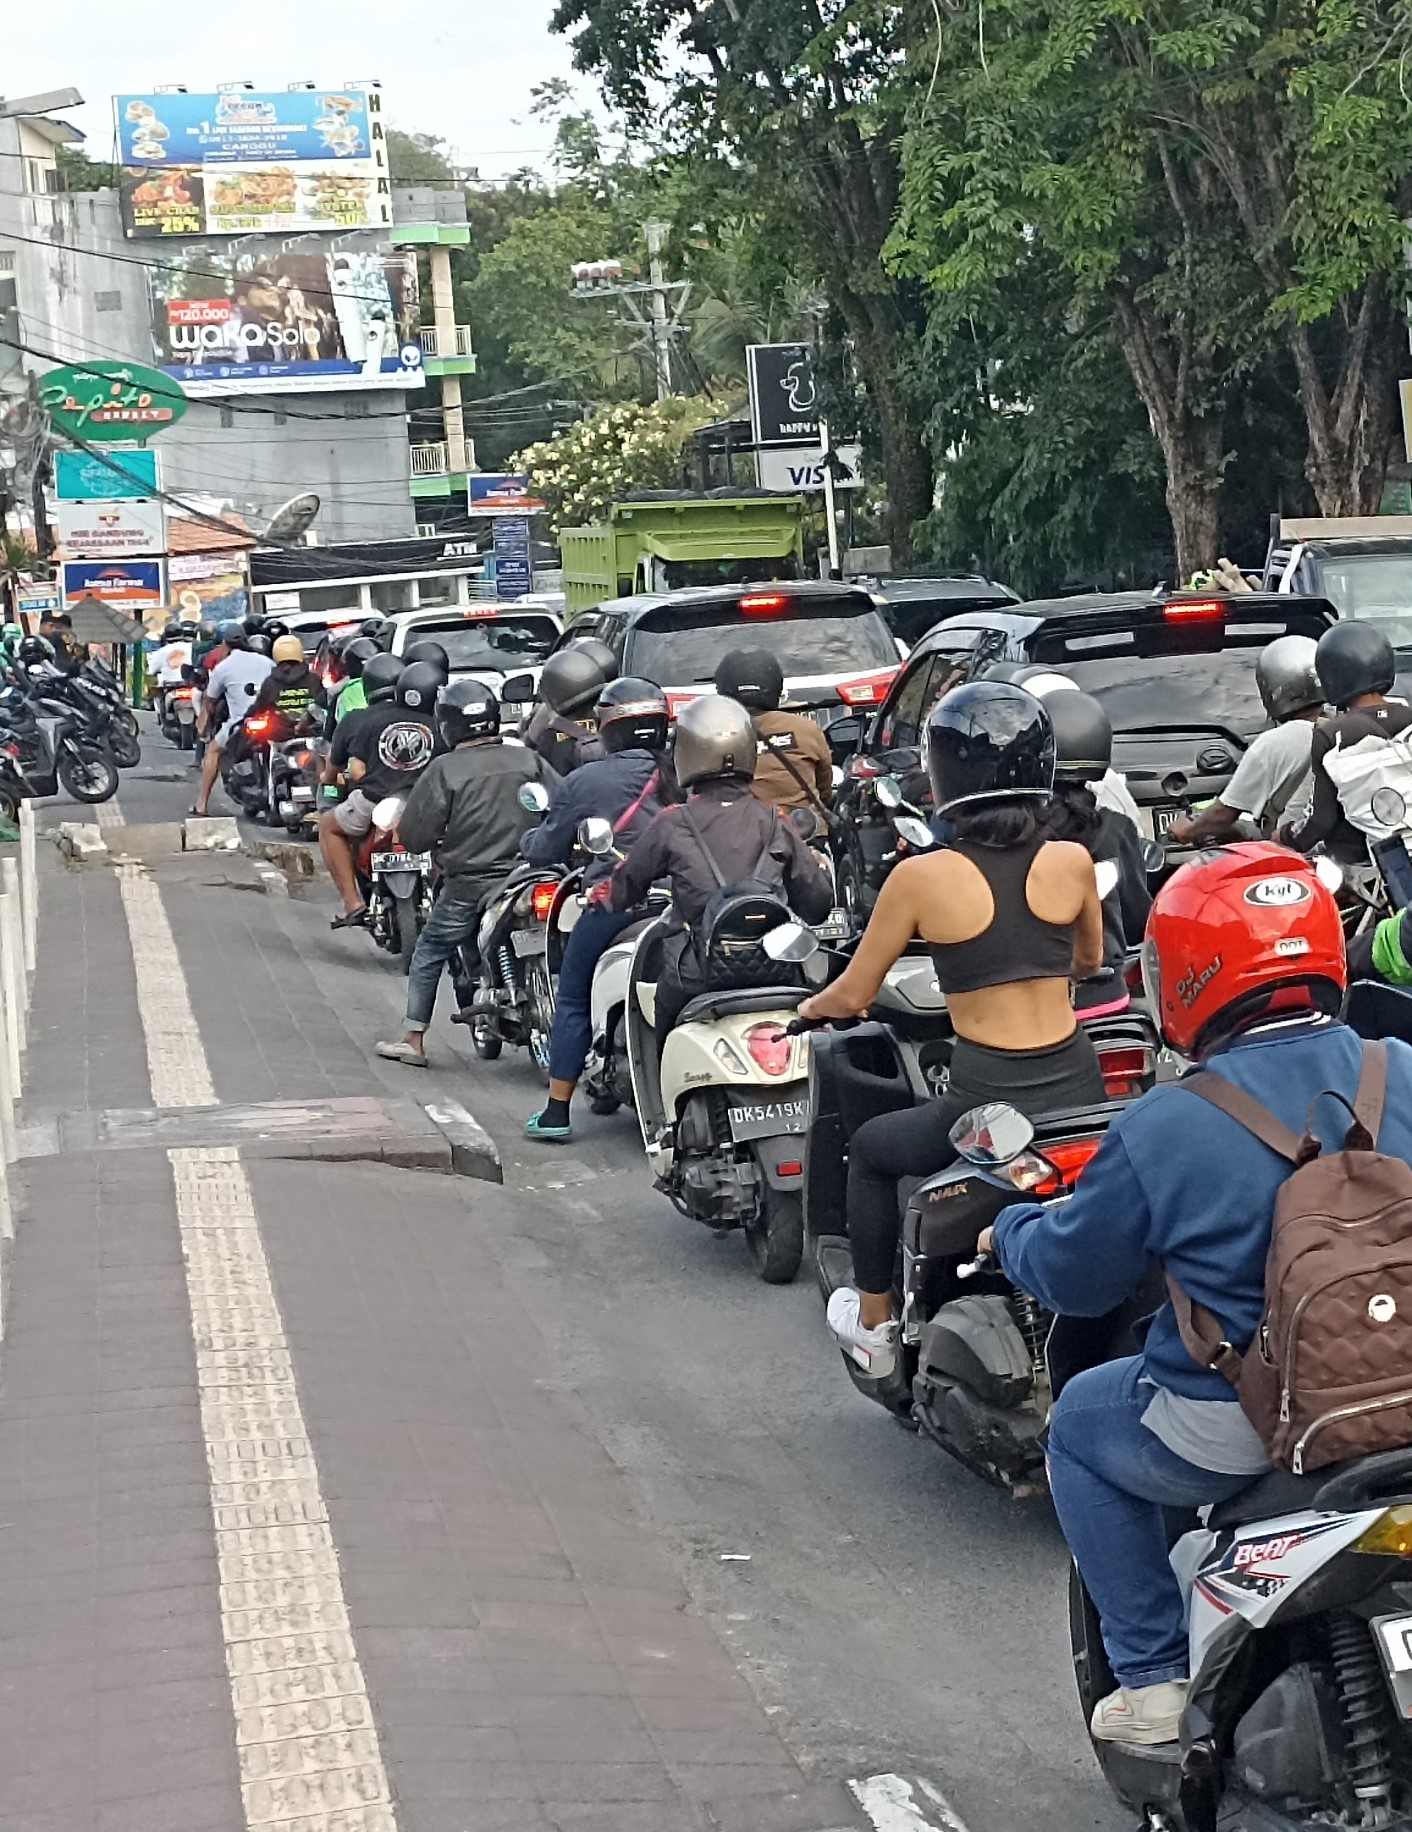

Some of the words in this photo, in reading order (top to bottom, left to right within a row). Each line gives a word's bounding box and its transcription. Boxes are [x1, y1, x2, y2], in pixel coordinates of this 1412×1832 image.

[368, 93, 391, 223] HALAL
[161, 216, 200, 233] 25%
[443, 543, 478, 557] ATM
